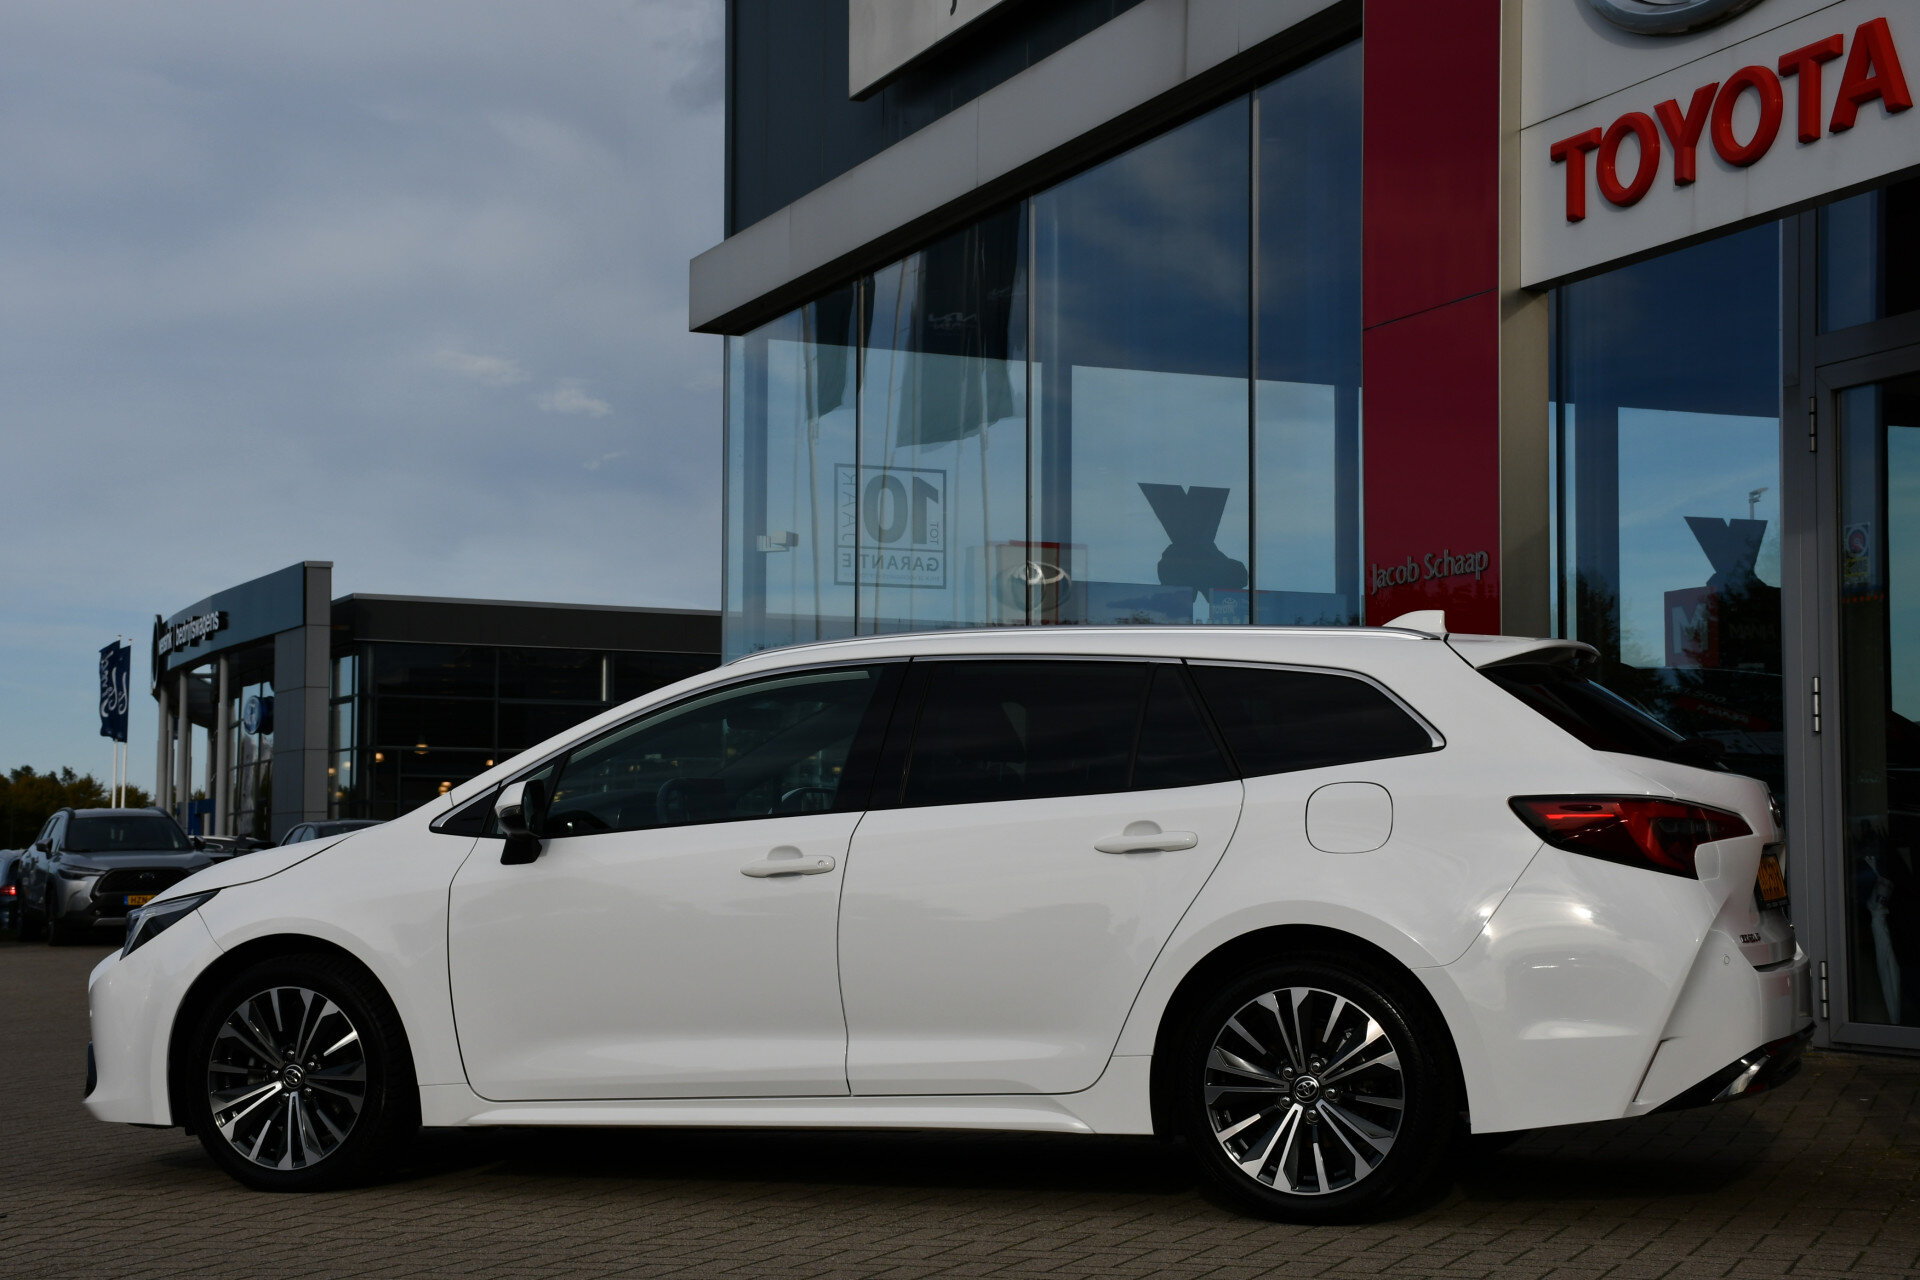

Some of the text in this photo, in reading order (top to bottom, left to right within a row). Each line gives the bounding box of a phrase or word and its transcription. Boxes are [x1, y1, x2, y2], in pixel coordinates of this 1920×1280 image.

[1550, 17, 1913, 222] TOYOTA
[1372, 549, 1489, 596] Jacob Schaap
